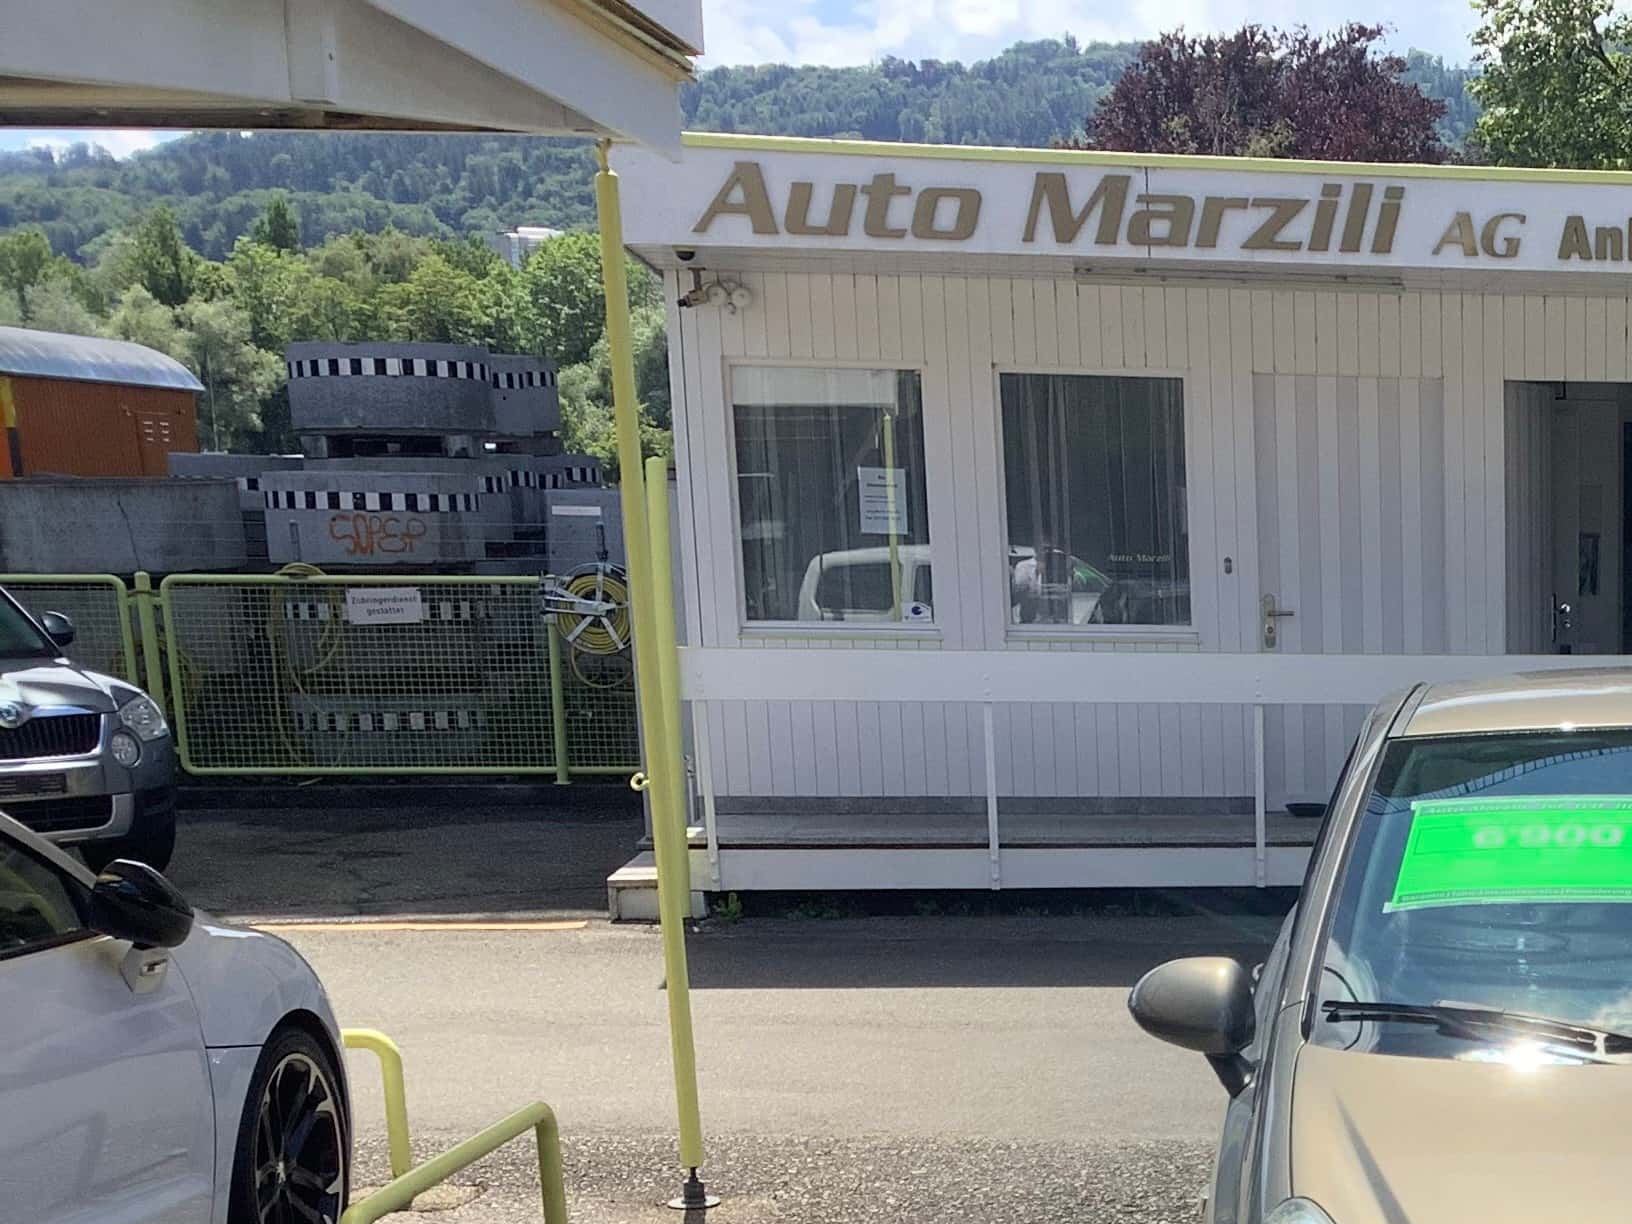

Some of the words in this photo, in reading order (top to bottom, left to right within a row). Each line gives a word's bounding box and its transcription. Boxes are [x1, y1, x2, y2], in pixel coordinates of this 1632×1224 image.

[692, 161, 982, 241] Auto
[1021, 172, 1405, 254] Marzili
[1432, 211, 1526, 259] AG
